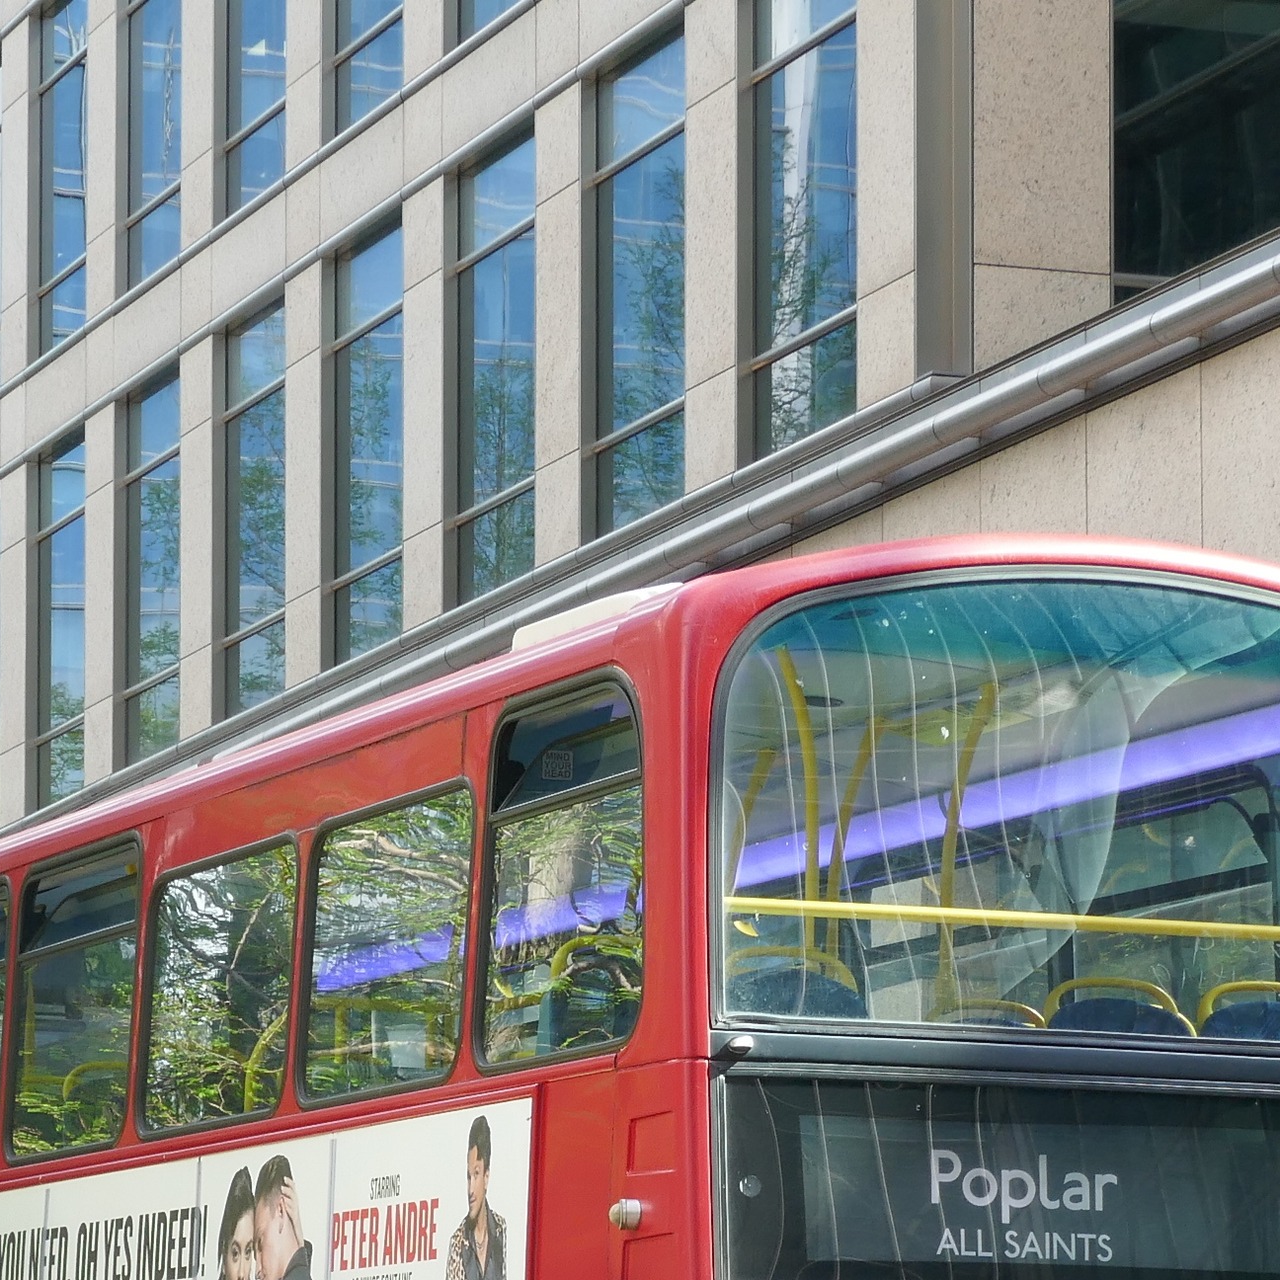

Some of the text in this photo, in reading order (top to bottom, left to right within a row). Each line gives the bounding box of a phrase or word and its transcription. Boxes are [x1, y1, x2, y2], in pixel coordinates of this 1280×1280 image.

[370, 1174, 401, 1200] STARRING
[930, 1149, 1118, 1224] Poplar
[331, 1198, 439, 1272] PETER ANDRE
[936, 1228, 1113, 1262] ALL SAINTS
